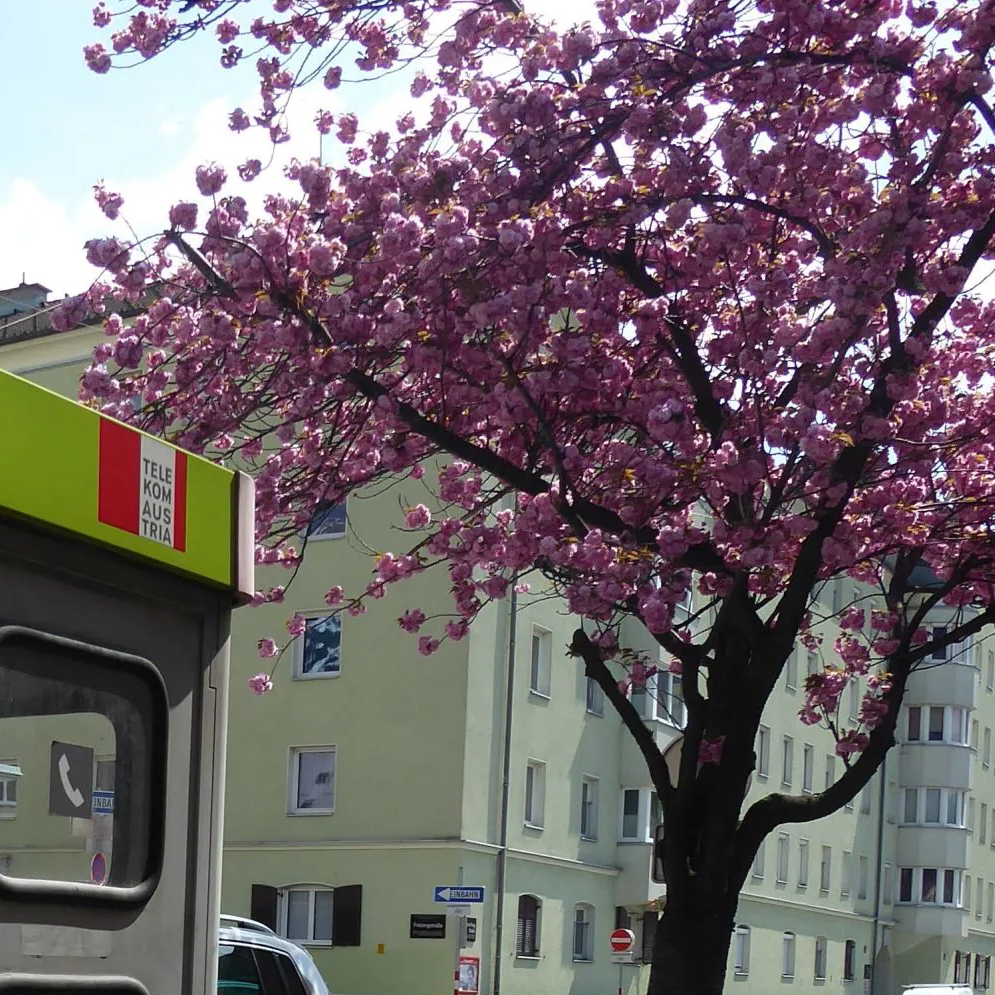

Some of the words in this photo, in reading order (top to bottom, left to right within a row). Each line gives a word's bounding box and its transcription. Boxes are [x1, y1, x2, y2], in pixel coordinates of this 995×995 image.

[143, 458, 172, 485] TELE
[143, 479, 172, 505] KOM
[142, 500, 171, 525] AUS
[142, 519, 172, 545] TRIA
[449, 890, 478, 898] EINBAHN
